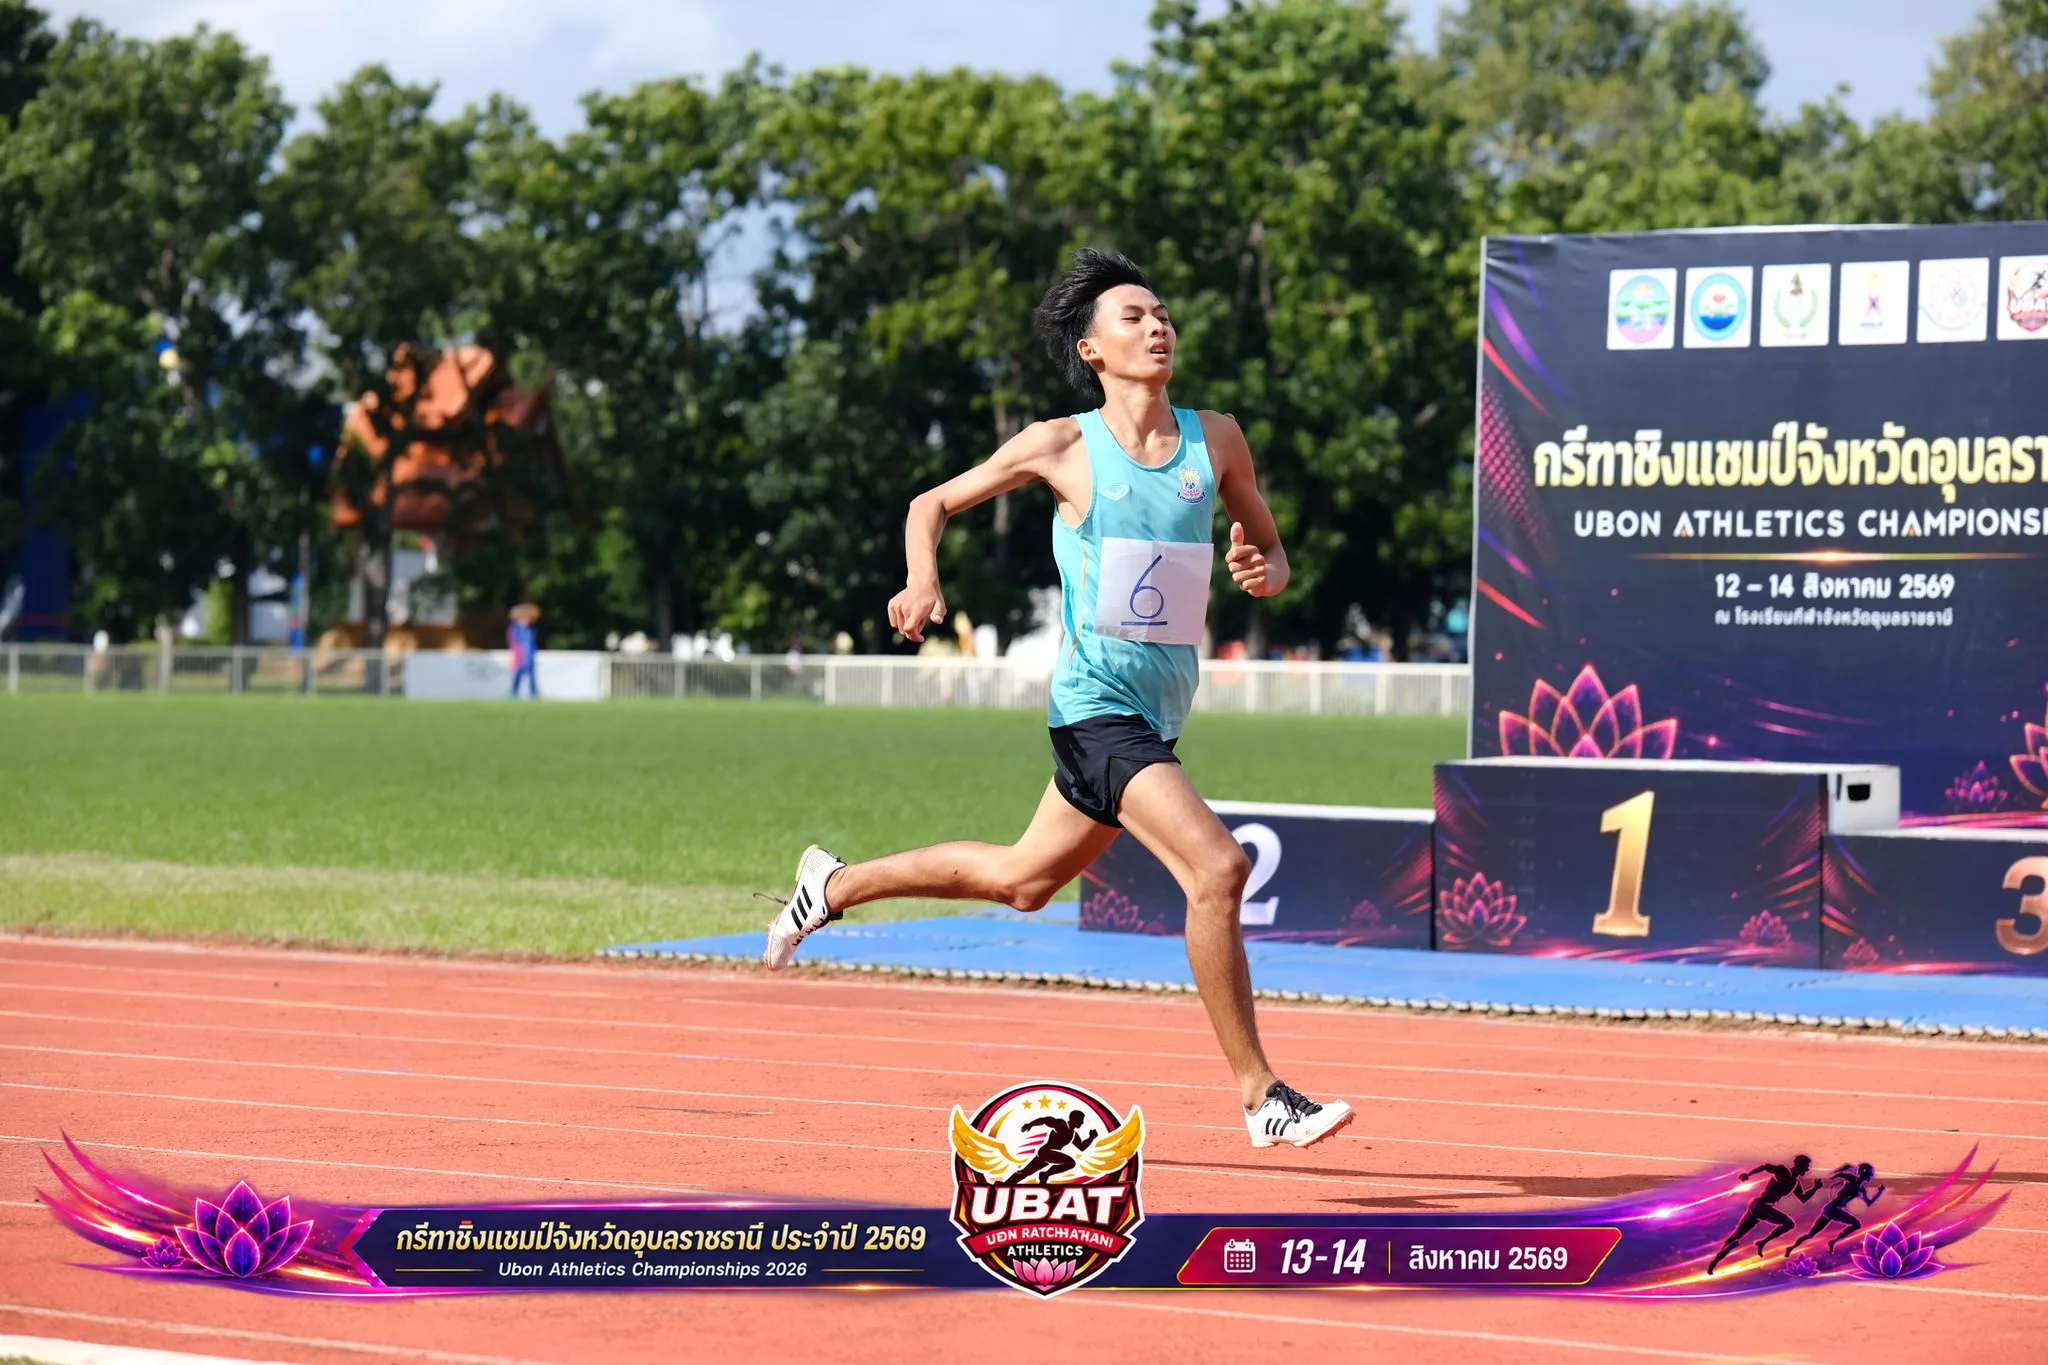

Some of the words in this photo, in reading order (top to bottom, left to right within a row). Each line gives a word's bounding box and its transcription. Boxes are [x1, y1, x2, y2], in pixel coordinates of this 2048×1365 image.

[1574, 510, 1662, 538] UBON
[1673, 509, 1846, 538] ATHLETICS
[1857, 507, 2048, 538] CHAMPIONS
[1130, 554, 1164, 619] 6
[1715, 573, 1741, 598] 12
[1769, 573, 1795, 598] 14
[1802, 572, 1892, 599] สิงหาคม
[1898, 573, 1956, 599] 2569
[1231, 822, 1283, 926] 2
[1592, 790, 1655, 937] 1
[1995, 855, 2048, 956] 3
